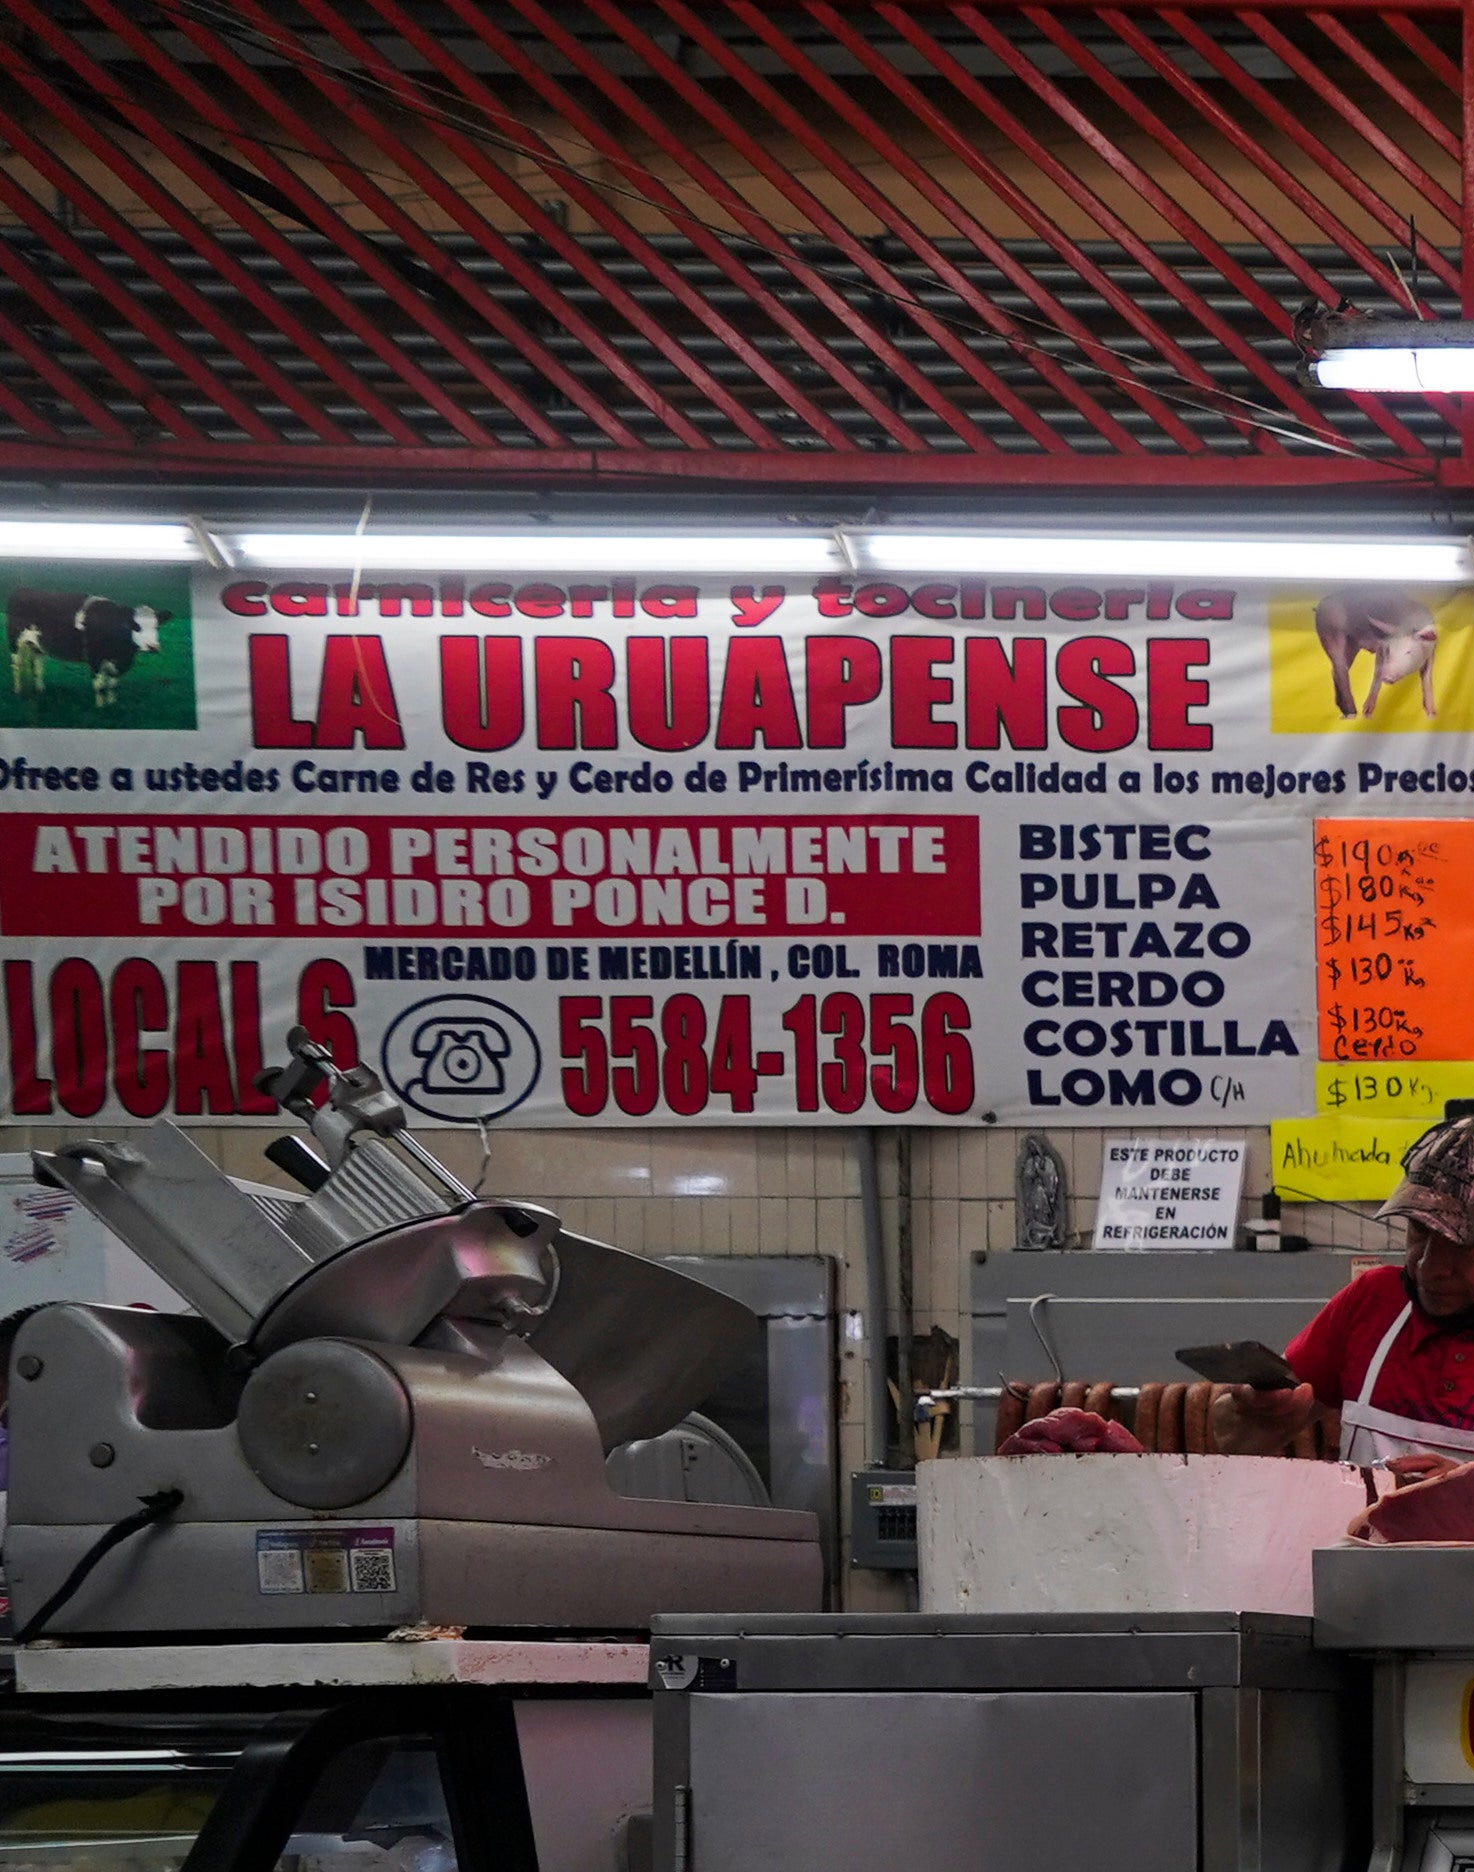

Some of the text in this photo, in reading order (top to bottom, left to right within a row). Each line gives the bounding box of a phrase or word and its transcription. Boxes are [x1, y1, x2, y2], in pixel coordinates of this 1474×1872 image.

[221, 576, 1238, 628] carniceria y tocineria
[248, 634, 1213, 753] LA URUAPENSE
[114, 768, 134, 792] a
[146, 763, 281, 793] ustedes
[292, 762, 400, 793] Carne
[411, 760, 456, 793] de
[468, 762, 526, 793] Res
[537, 768, 559, 799] y
[568, 761, 673, 794] Cerdo
[684, 761, 728, 793] de
[738, 759, 954, 794] Primerísima
[966, 761, 1107, 794] Calidad
[1118, 770, 1141, 793] a
[1153, 763, 1200, 794] los
[1211, 764, 1346, 800] mejores
[33, 825, 946, 876] ATENDIDO PERSONALMENTE
[1019, 823, 1211, 862] BISTEC
[138, 877, 847, 926] POR ISIDRO PONCE D.
[1020, 872, 1221, 910] PULPA
[1021, 921, 1252, 959] RETAZO
[1321, 910, 1402, 946] $145
[365, 945, 537, 982] MERCADO
[547, 946, 589, 981] DE
[787, 947, 860, 981] COL.
[877, 946, 984, 981] ROMA
[1326, 952, 1392, 991] $130
[1021, 969, 1225, 1008] CERDO
[1328, 1001, 1395, 1034] $130
[3, 958, 271, 1120] LOCAL
[559, 991, 976, 1118] 5584-1356
[1022, 1019, 1300, 1057] COSTILLA
[1333, 1034, 1417, 1061] Cerdo
[1026, 1068, 1203, 1108] LOMO
[1326, 1072, 1403, 1108] $130
[1110, 1148, 1239, 1162] ESTE PRODUCTO
[1282, 1138, 1391, 1169] Ahumada
[1115, 1187, 1221, 1200] MANTENERSE
[1150, 1168, 1191, 1181] DEBE
[1103, 1222, 1228, 1239] REFRIGERACIÓN
[1155, 1206, 1176, 1219] EN
